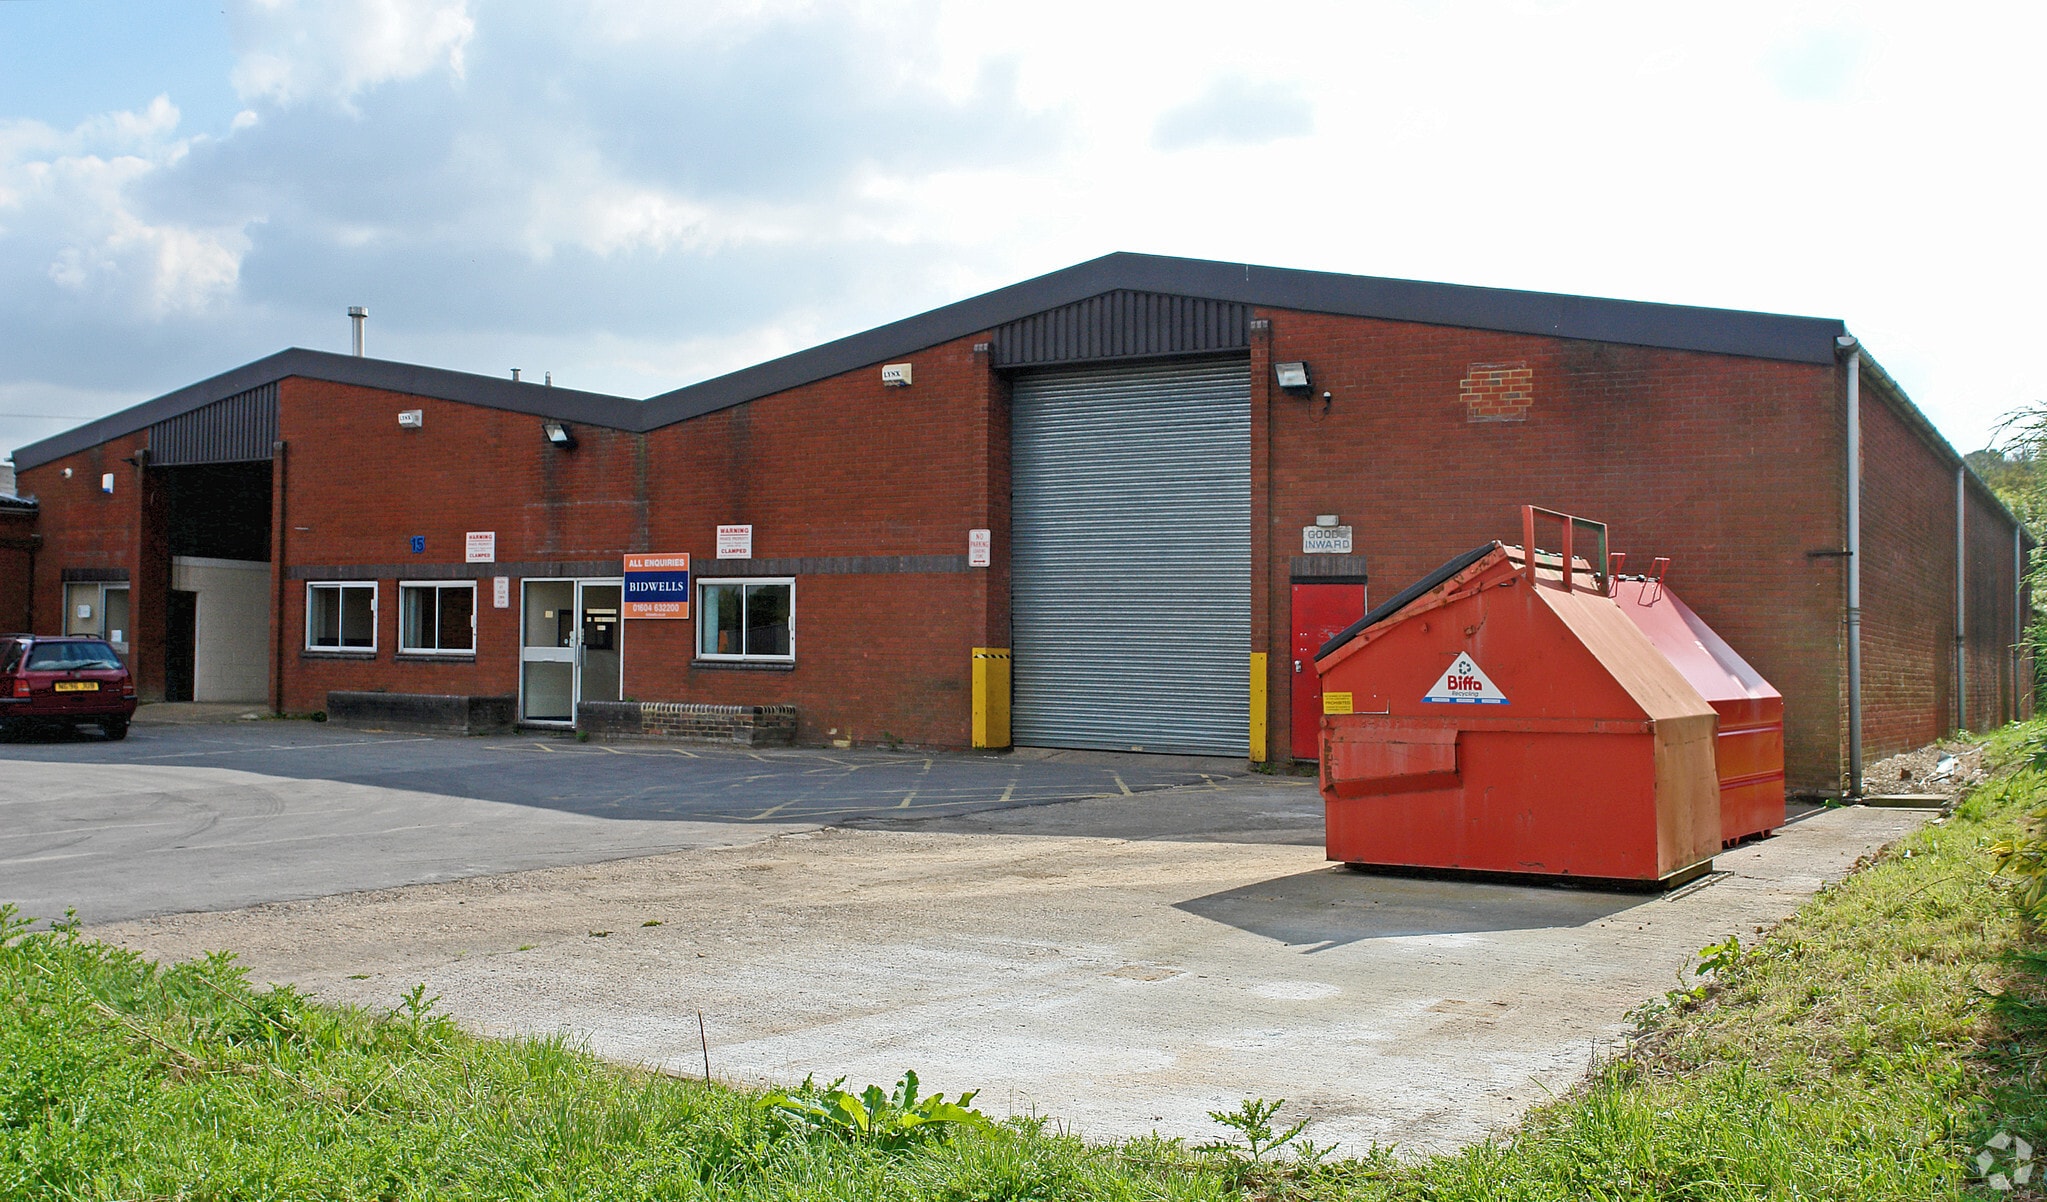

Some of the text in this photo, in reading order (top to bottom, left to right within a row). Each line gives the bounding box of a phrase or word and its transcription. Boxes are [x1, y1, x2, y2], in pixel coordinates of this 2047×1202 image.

[884, 370, 901, 378] LYNX
[410, 535, 425, 553] 15
[1305, 540, 1350, 549] INWARD
[629, 558, 685, 567] ALL ENQUIRIES
[629, 581, 684, 592] BIDWELLS
[632, 604, 680, 612] 01604 632200
[1447, 675, 1483, 691] Biffa
